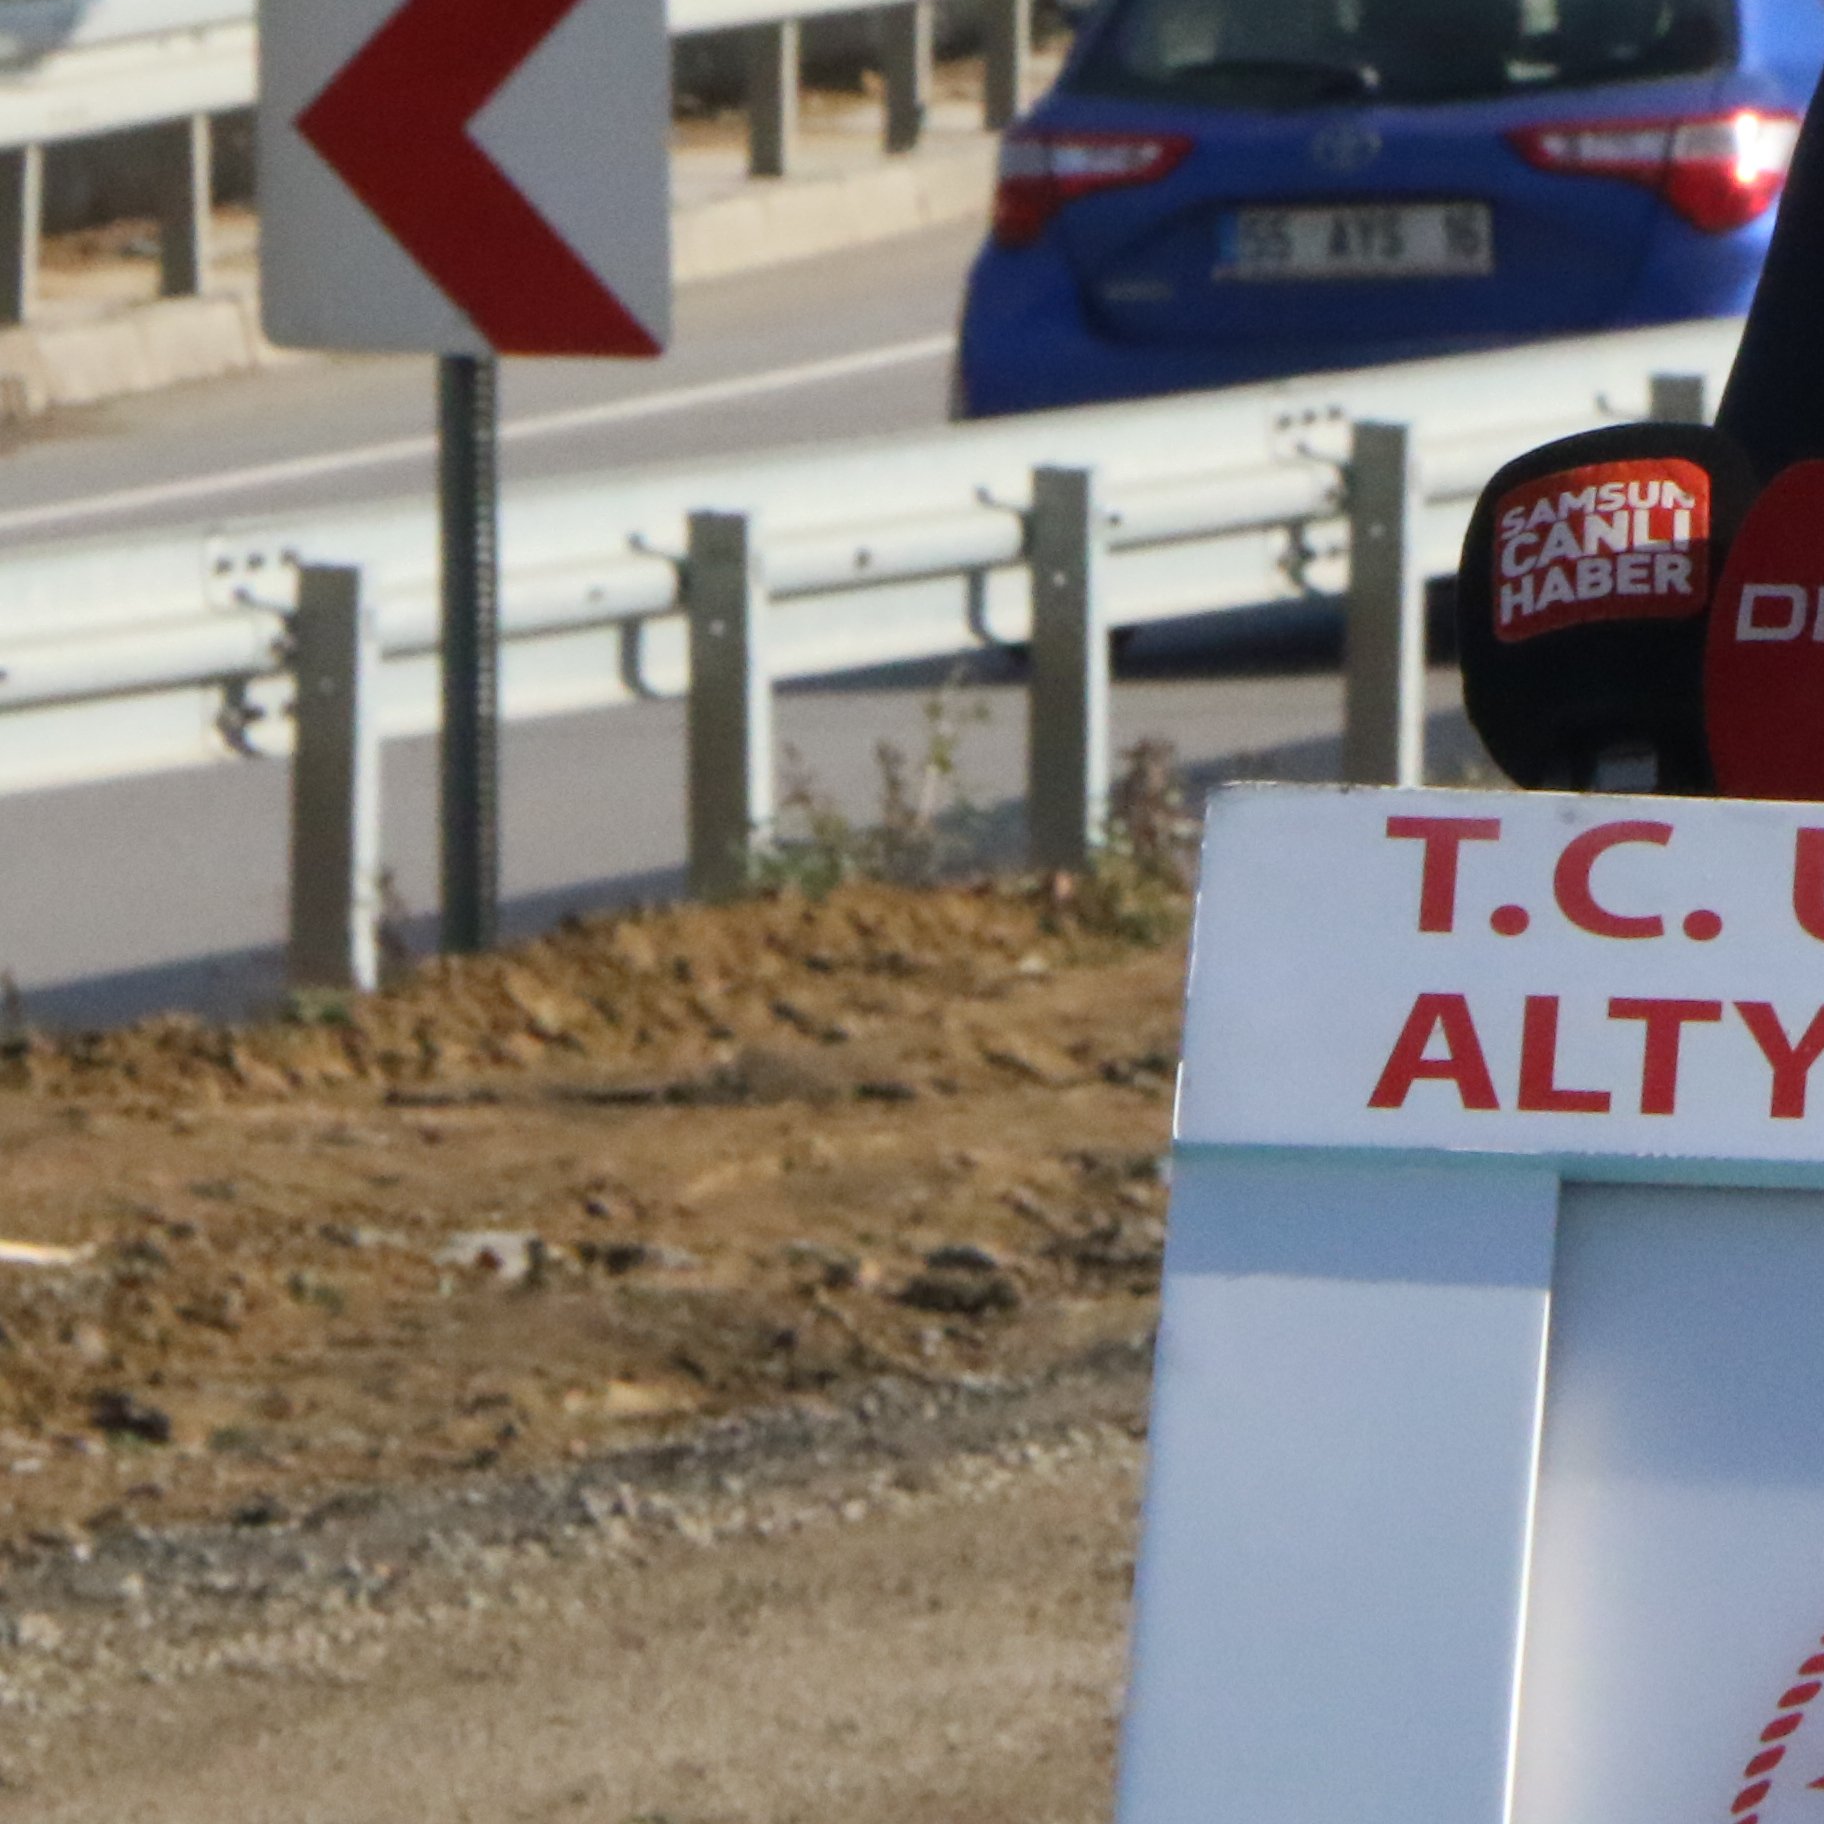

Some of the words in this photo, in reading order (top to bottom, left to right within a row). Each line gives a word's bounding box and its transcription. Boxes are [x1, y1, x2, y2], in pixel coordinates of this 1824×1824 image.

[1501, 480, 1695, 540] SAMSUN
[1501, 508, 1692, 578] CANLI
[1501, 552, 1693, 626] HABER
[1388, 816, 1723, 941] T.C.
